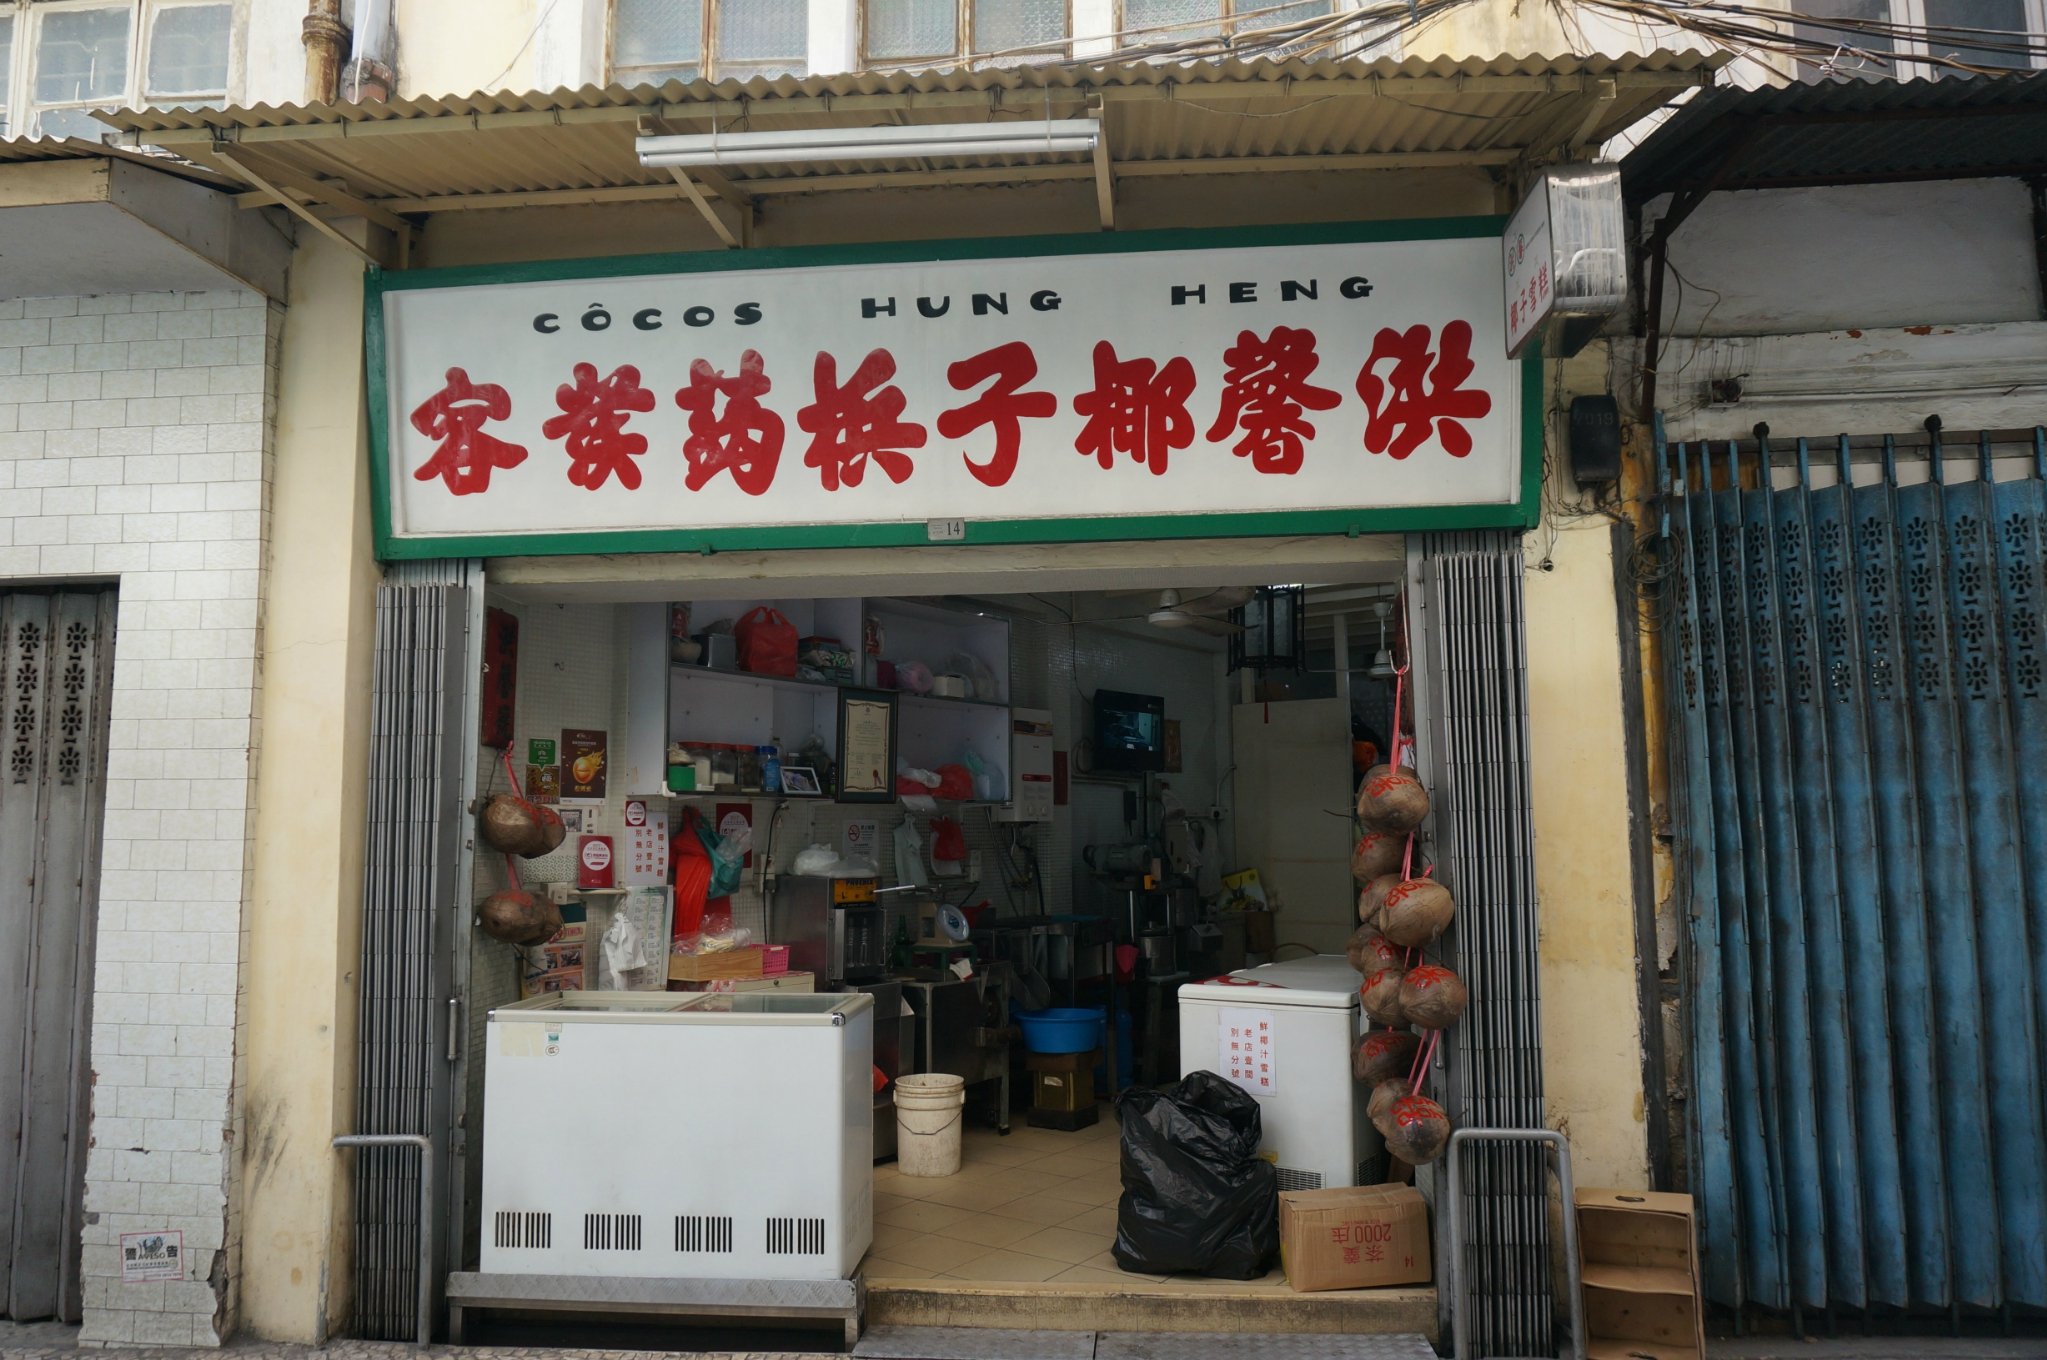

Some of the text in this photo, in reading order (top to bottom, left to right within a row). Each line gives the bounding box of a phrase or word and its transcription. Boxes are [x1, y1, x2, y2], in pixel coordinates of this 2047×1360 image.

[533, 276, 1374, 334] CÔCOS HUNG HENG
[1510, 261, 1550, 334] 椰子雪糕
[947, 521, 960, 536] 14
[1230, 1027, 1240, 1078] 別無分號
[1243, 1028, 1254, 1080] 老店壹間
[1259, 1021, 1269, 1087] 鮮椰汁雪糕
[138, 1252, 165, 1260] AVISO
[1355, 1223, 1392, 1244] 2000
[1404, 1255, 1415, 1269] 14
